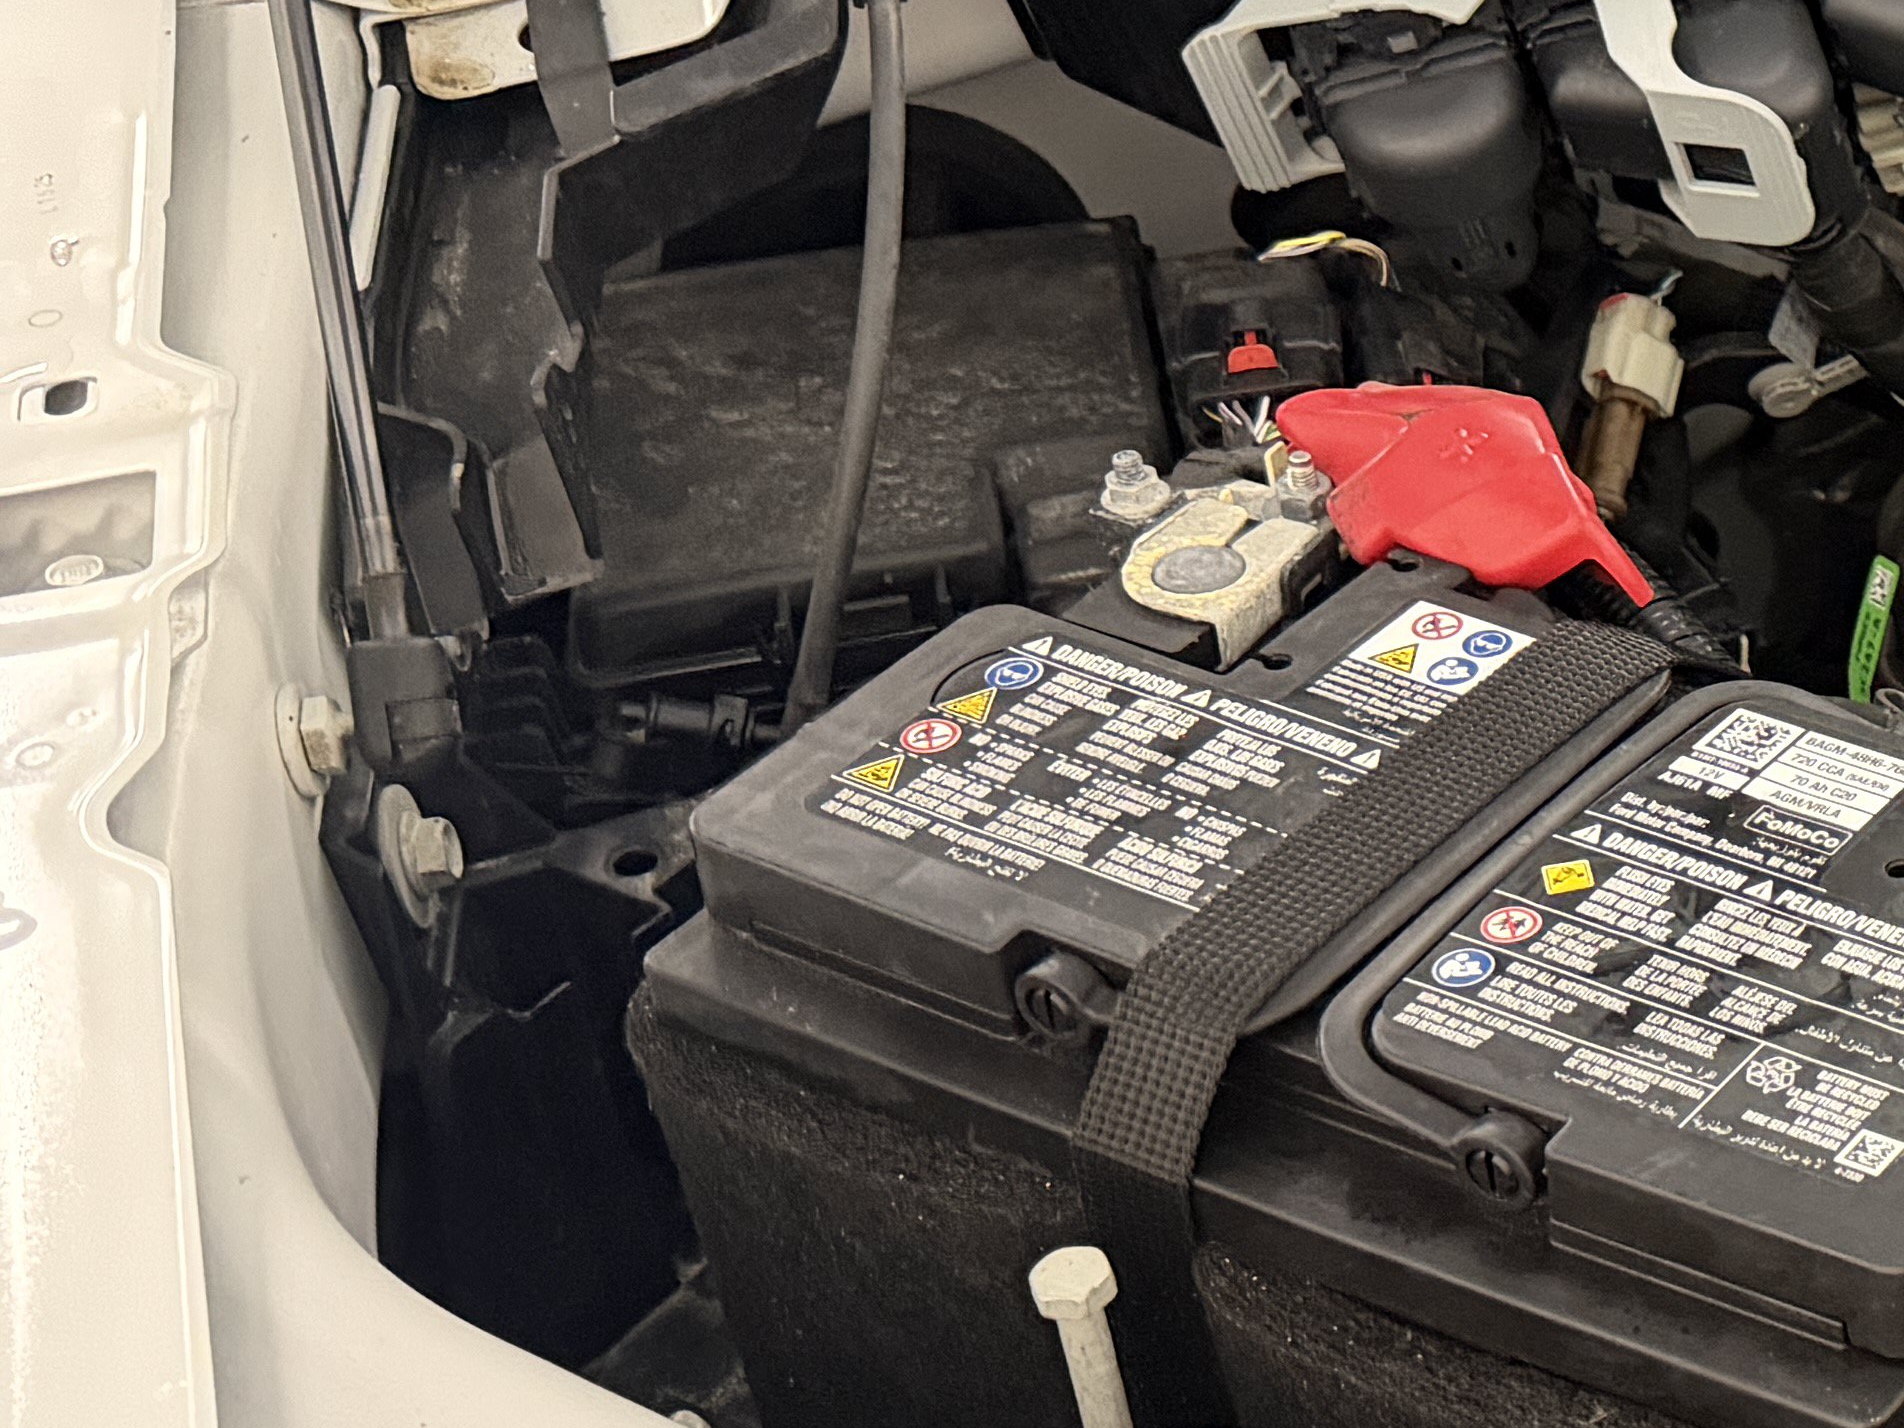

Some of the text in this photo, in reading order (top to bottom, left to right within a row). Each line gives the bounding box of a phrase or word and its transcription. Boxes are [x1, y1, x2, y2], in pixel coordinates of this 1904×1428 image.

[1046, 644, 1191, 699] DANGER/POISON
[1204, 697, 1362, 757] PELIGRO/VENENO
[1696, 766, 1725, 780] 12V
[1789, 752, 1819, 767] 720
[1815, 761, 1848, 777] CCA
[1767, 788, 1844, 819] AGM/VRLA
[1788, 774, 1858, 802] 70 Ah C20
[1751, 810, 1845, 850] FoMoCo
[1599, 831, 1750, 891] DANGER/POISON
